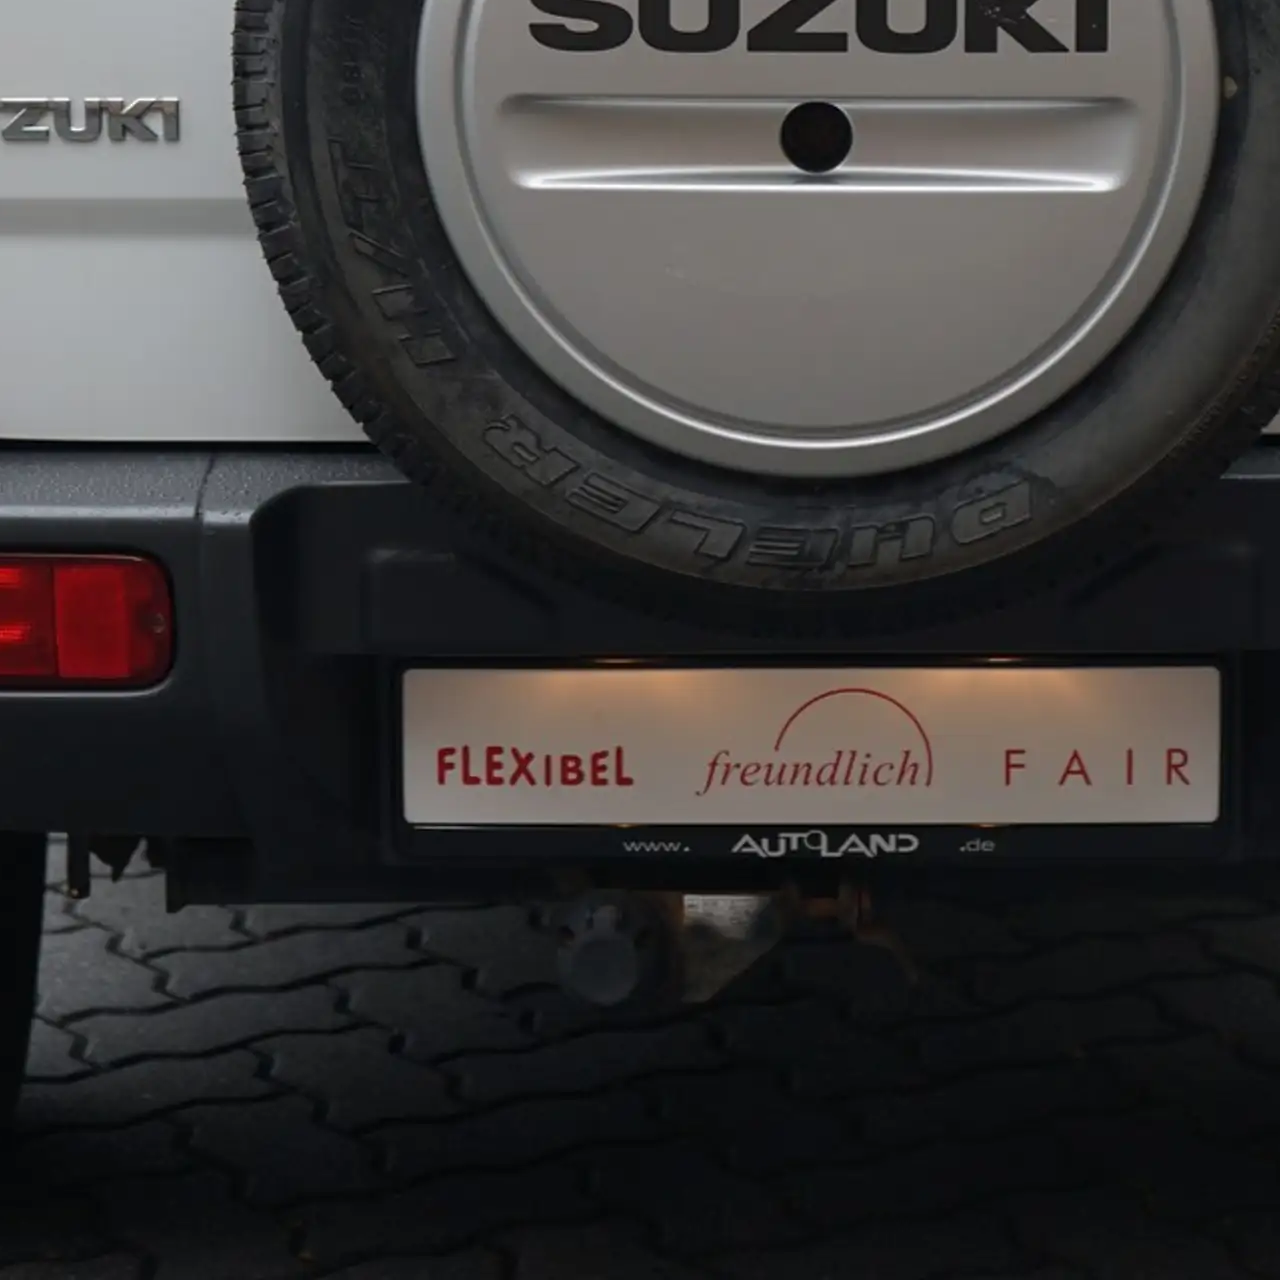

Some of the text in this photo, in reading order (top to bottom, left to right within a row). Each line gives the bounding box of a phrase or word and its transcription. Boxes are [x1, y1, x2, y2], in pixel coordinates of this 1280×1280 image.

[481, 413, 1034, 563] DUELER
[436, 744, 1193, 797] FLEXIBEL freundlich FAIR
[622, 829, 997, 858] www. AUTOLAND .de
